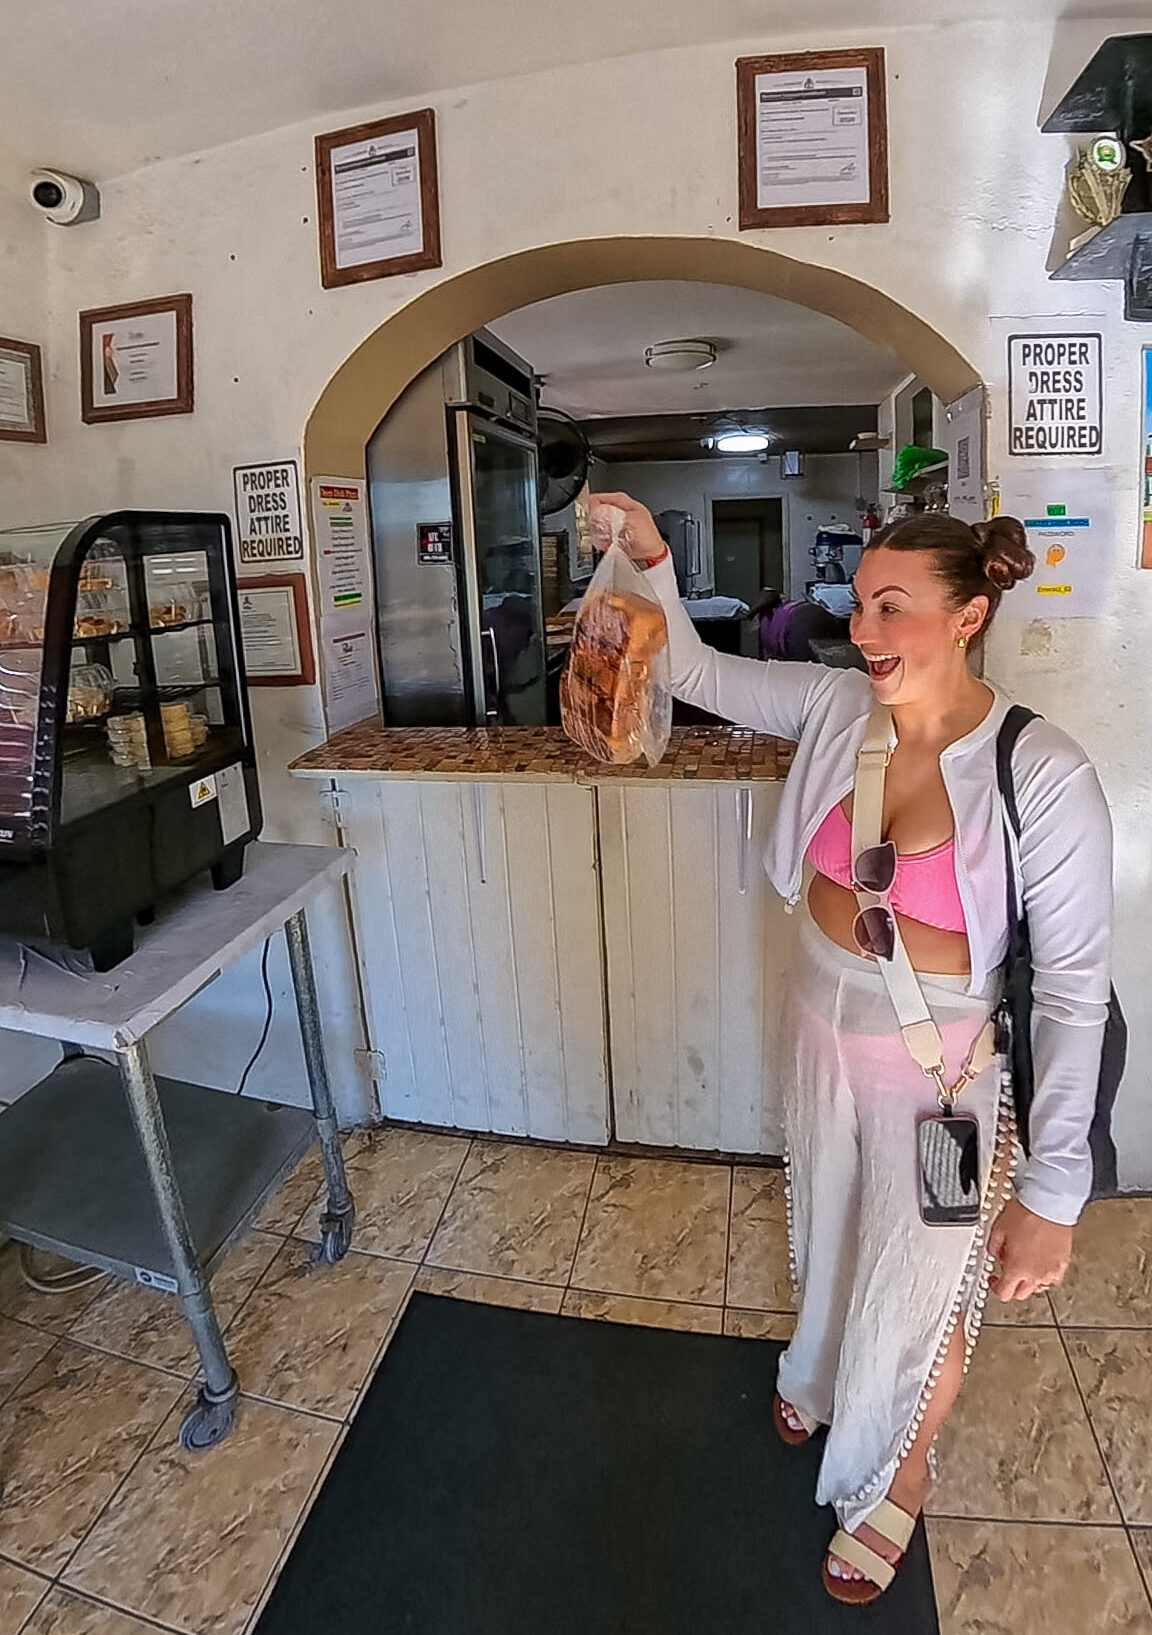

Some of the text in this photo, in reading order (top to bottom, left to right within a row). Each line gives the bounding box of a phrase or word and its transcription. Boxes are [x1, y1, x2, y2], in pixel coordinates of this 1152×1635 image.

[1022, 343, 1090, 366] PROPER
[1029, 370, 1083, 393] DRESS
[1026, 398, 1086, 421] ATTIRE
[1013, 426, 1099, 449] REQUIRED
[242, 469, 290, 492] PROPER
[248, 492, 287, 513] DRESS
[249, 514, 290, 535] ATTIRE
[242, 536, 300, 558] REQUIRED
